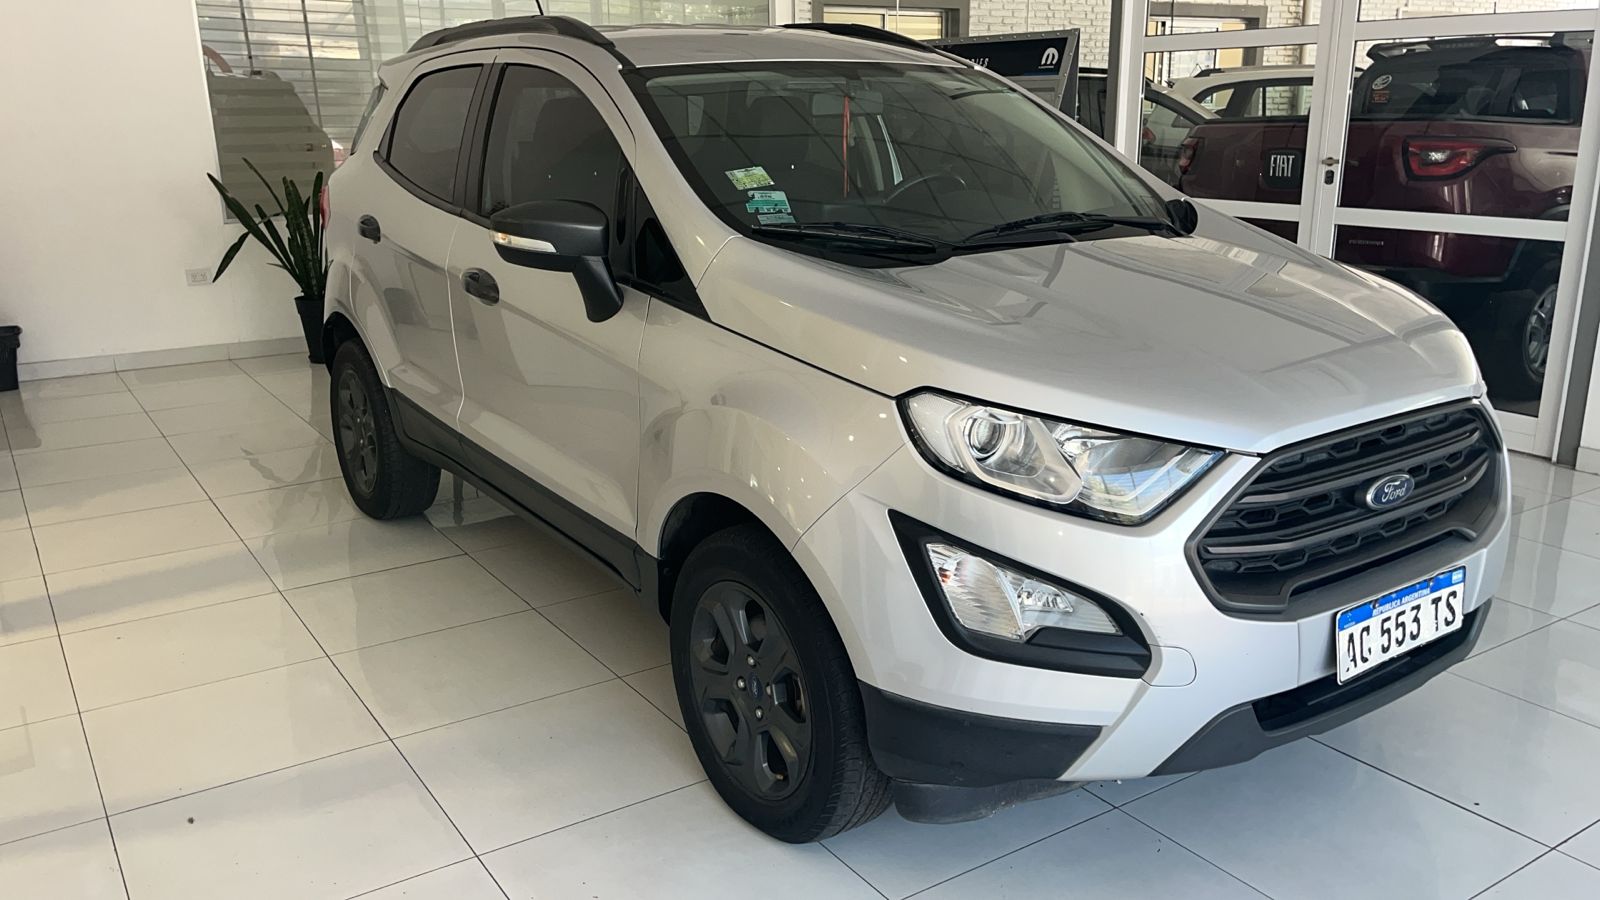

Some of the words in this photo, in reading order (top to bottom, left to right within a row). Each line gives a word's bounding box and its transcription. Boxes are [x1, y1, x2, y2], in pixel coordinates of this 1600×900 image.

[1270, 154, 1295, 177] FIAT
[1381, 481, 1408, 503] Ford
[1345, 624, 1372, 673] AC
[1380, 603, 1422, 654] 553
[1430, 590, 1459, 632] TS
